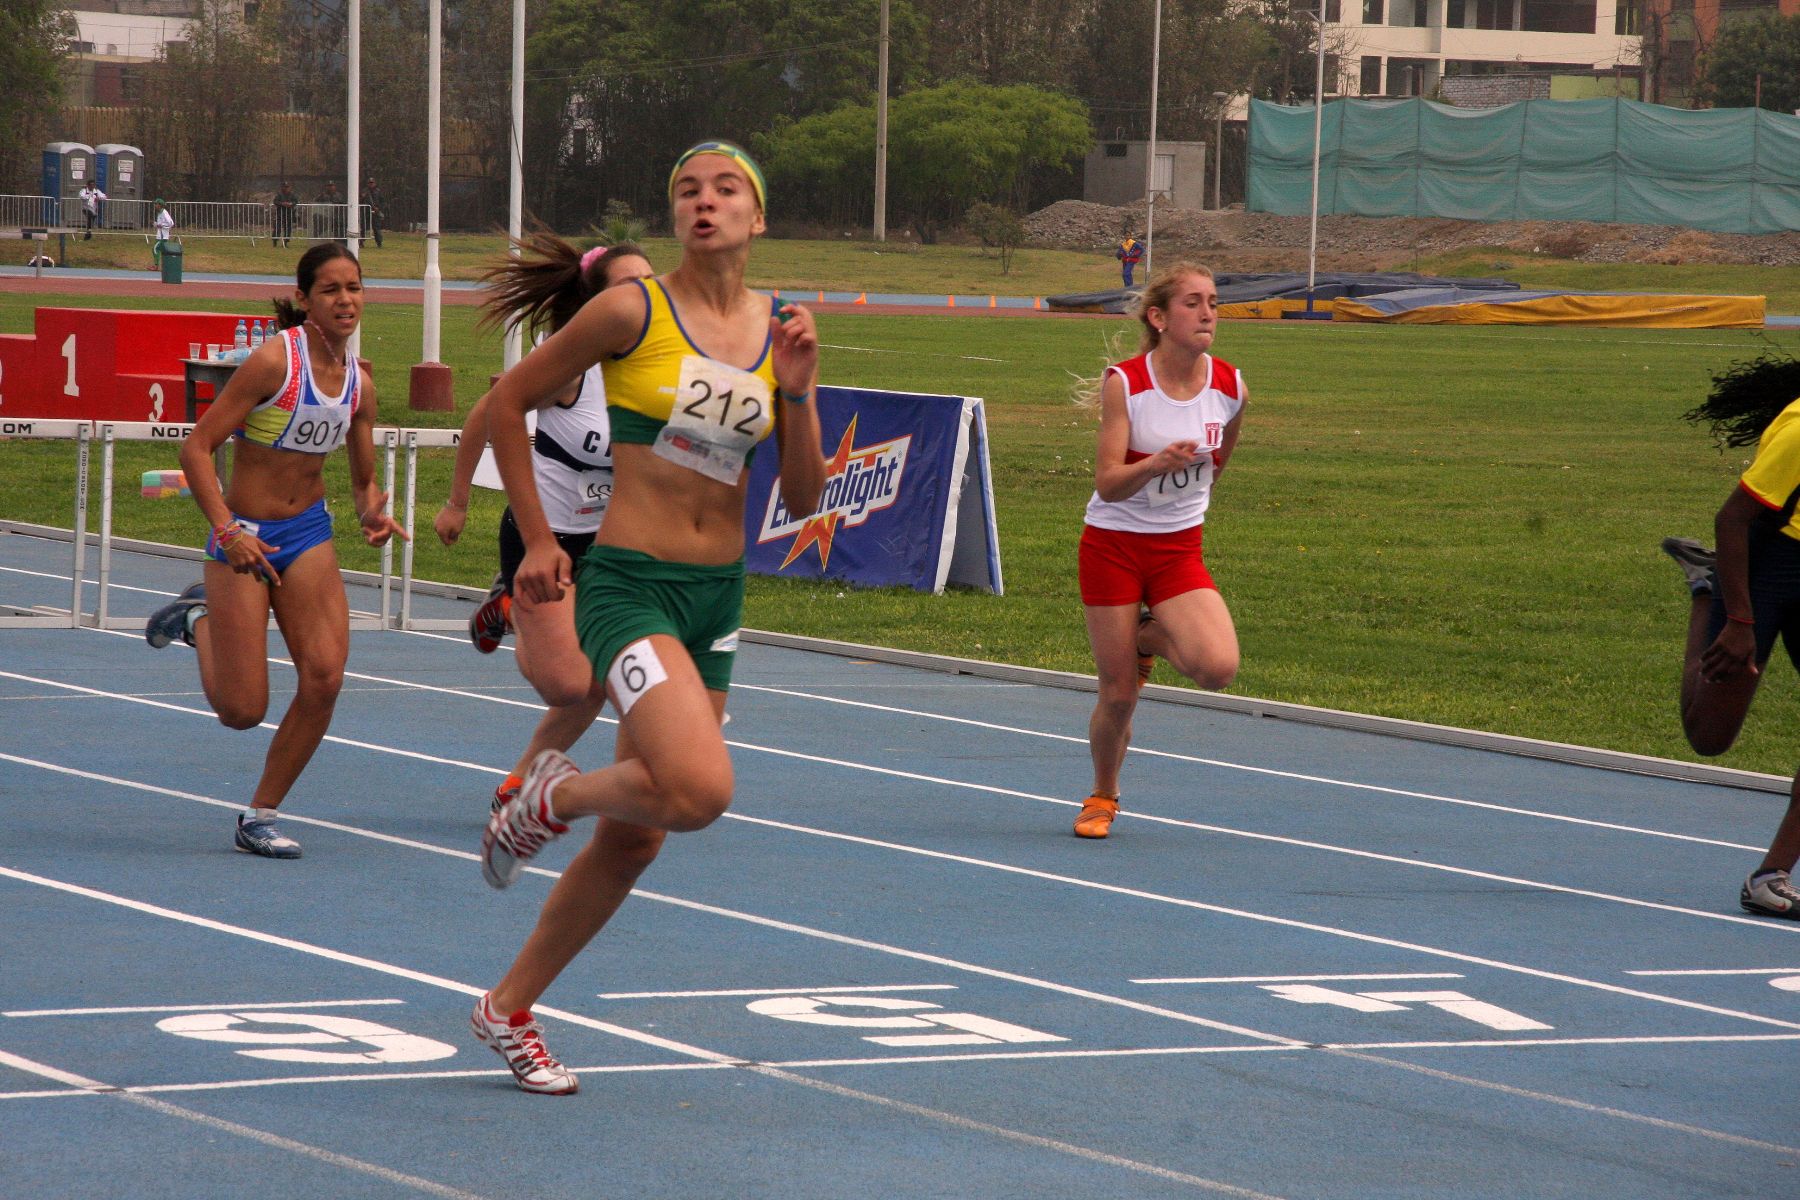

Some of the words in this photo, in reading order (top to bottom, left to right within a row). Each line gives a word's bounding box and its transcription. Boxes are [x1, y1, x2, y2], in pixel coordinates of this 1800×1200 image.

[61, 333, 79, 397] 1
[148, 382, 164, 423] 3
[683, 379, 762, 436] 212
[294, 420, 344, 447] 901
[1152, 461, 1206, 494] 707
[621, 654, 647, 693] 6
